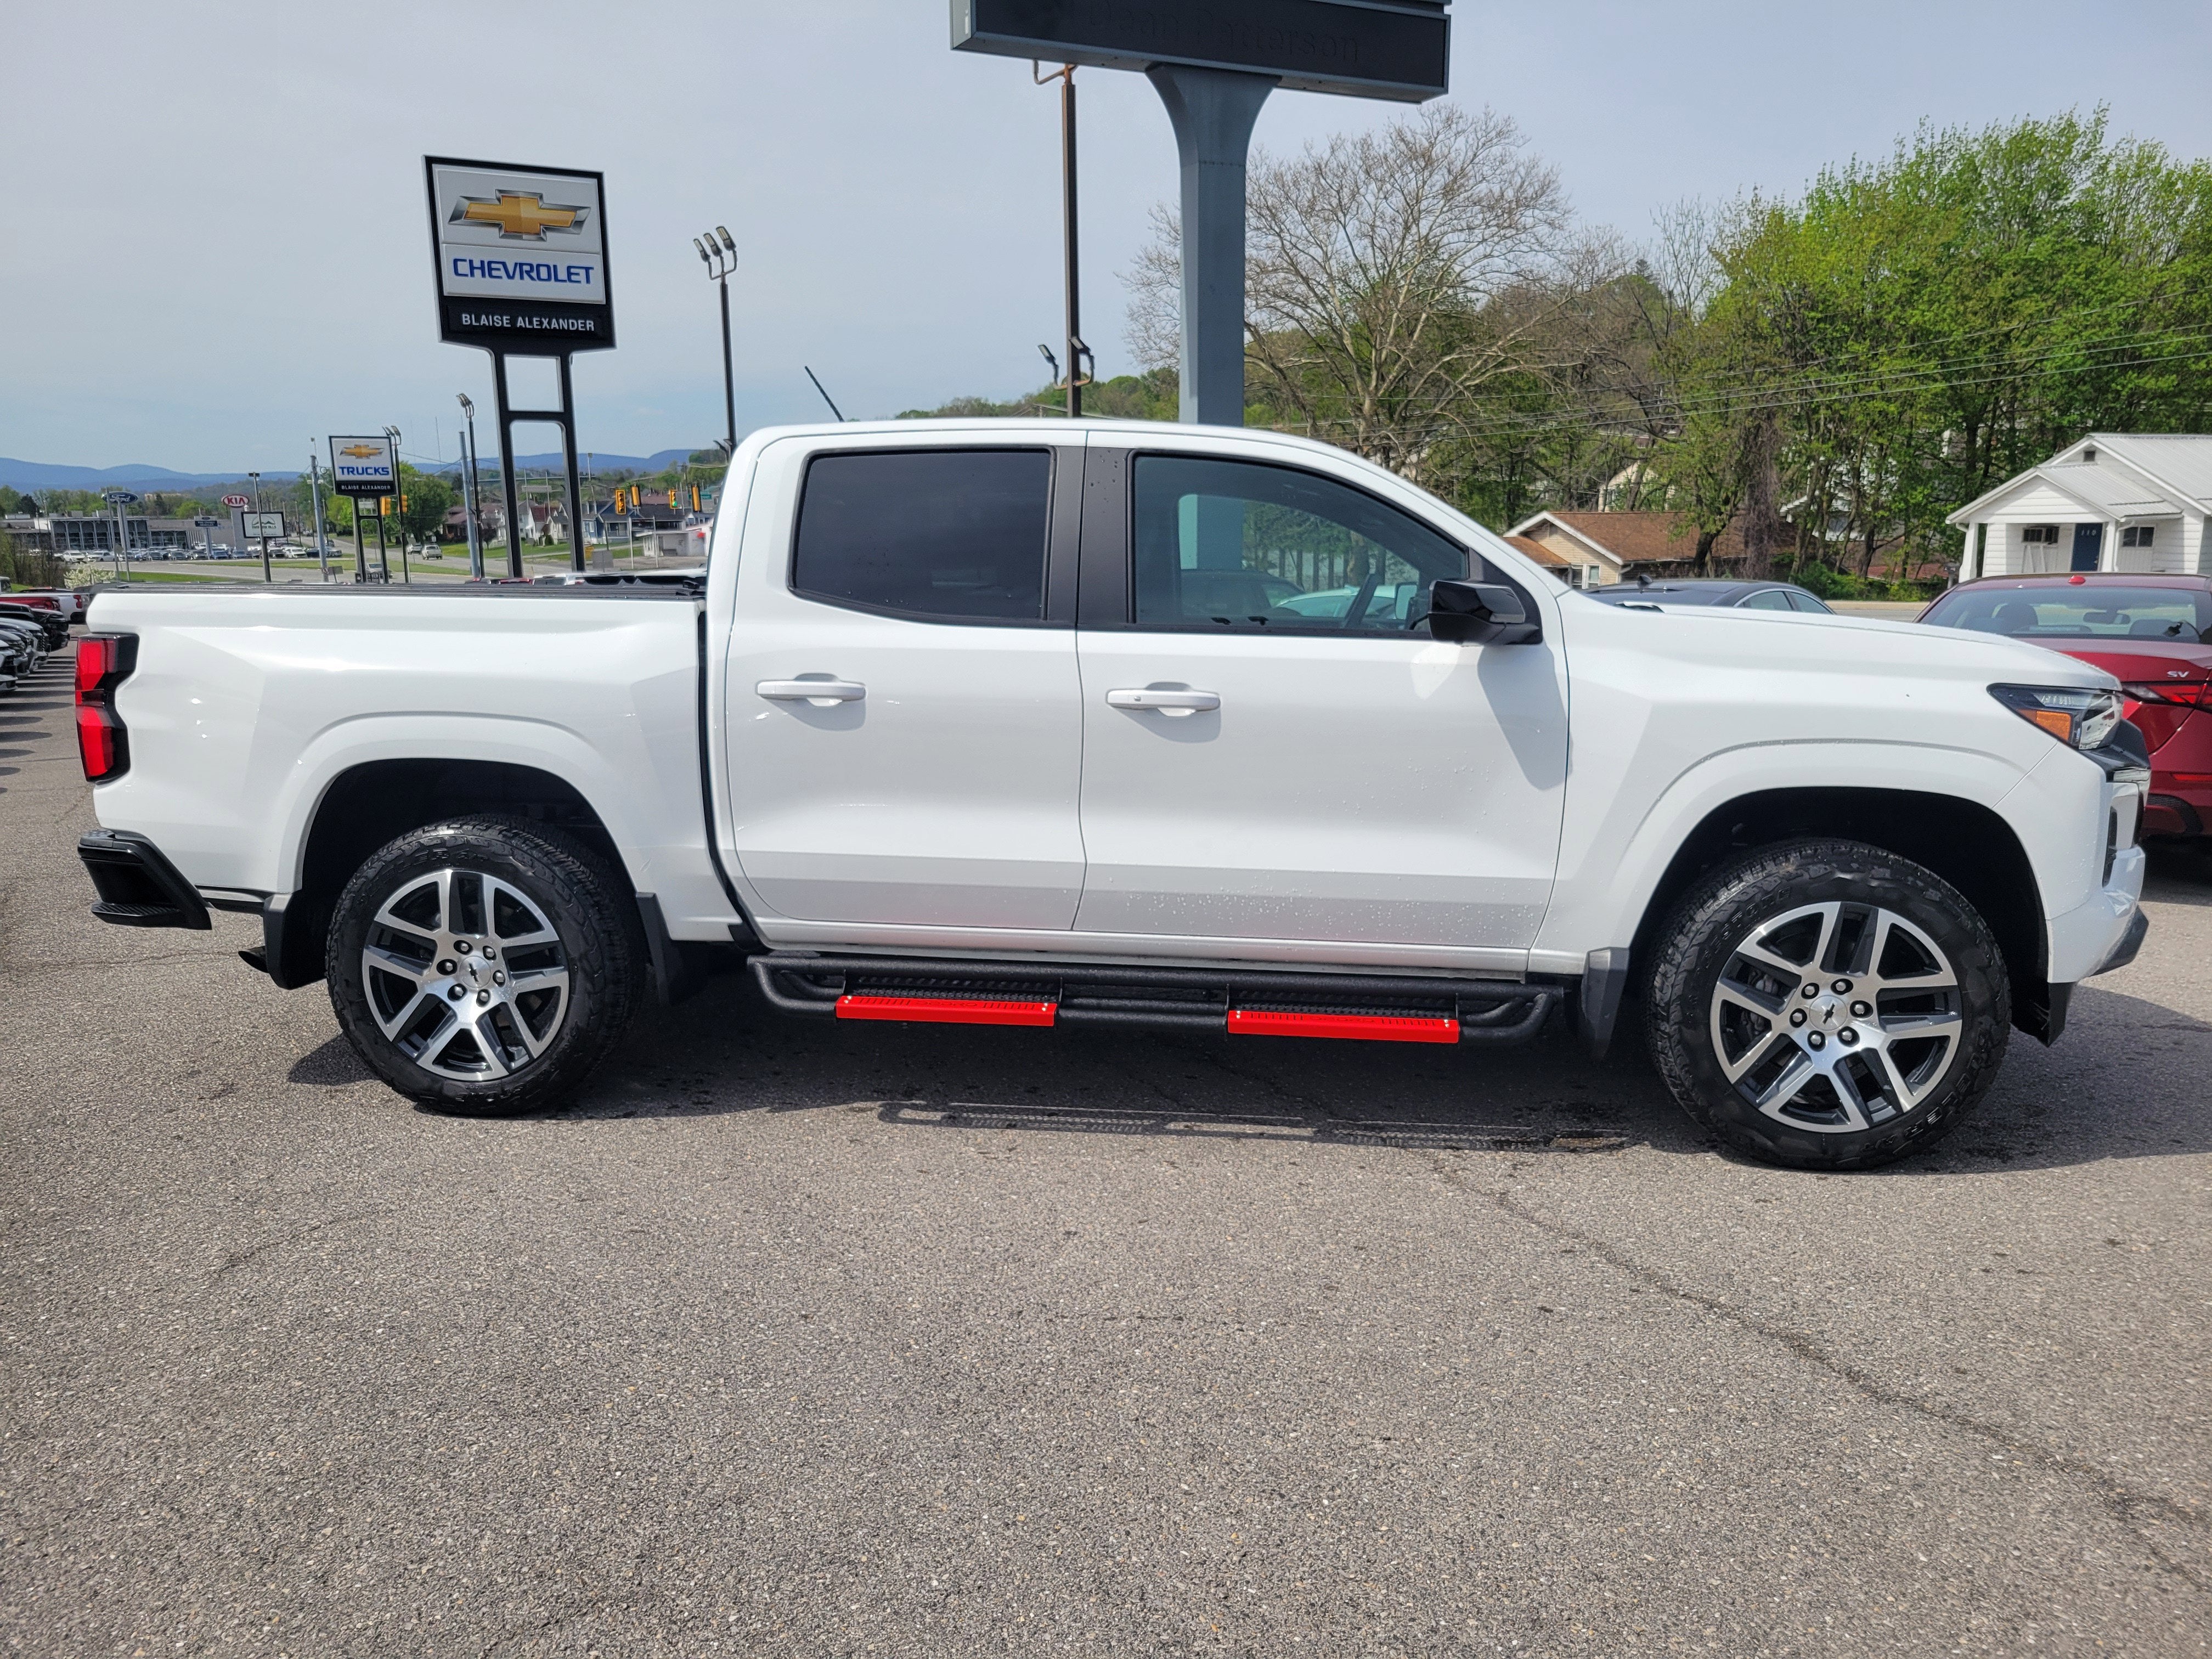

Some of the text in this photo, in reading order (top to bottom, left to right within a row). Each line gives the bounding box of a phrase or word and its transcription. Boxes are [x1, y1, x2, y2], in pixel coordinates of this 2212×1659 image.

[453, 258, 594, 284] CHEVROLET
[462, 313, 595, 331] BLAISE ALEXANDER
[338, 466, 390, 476] TRUCKS
